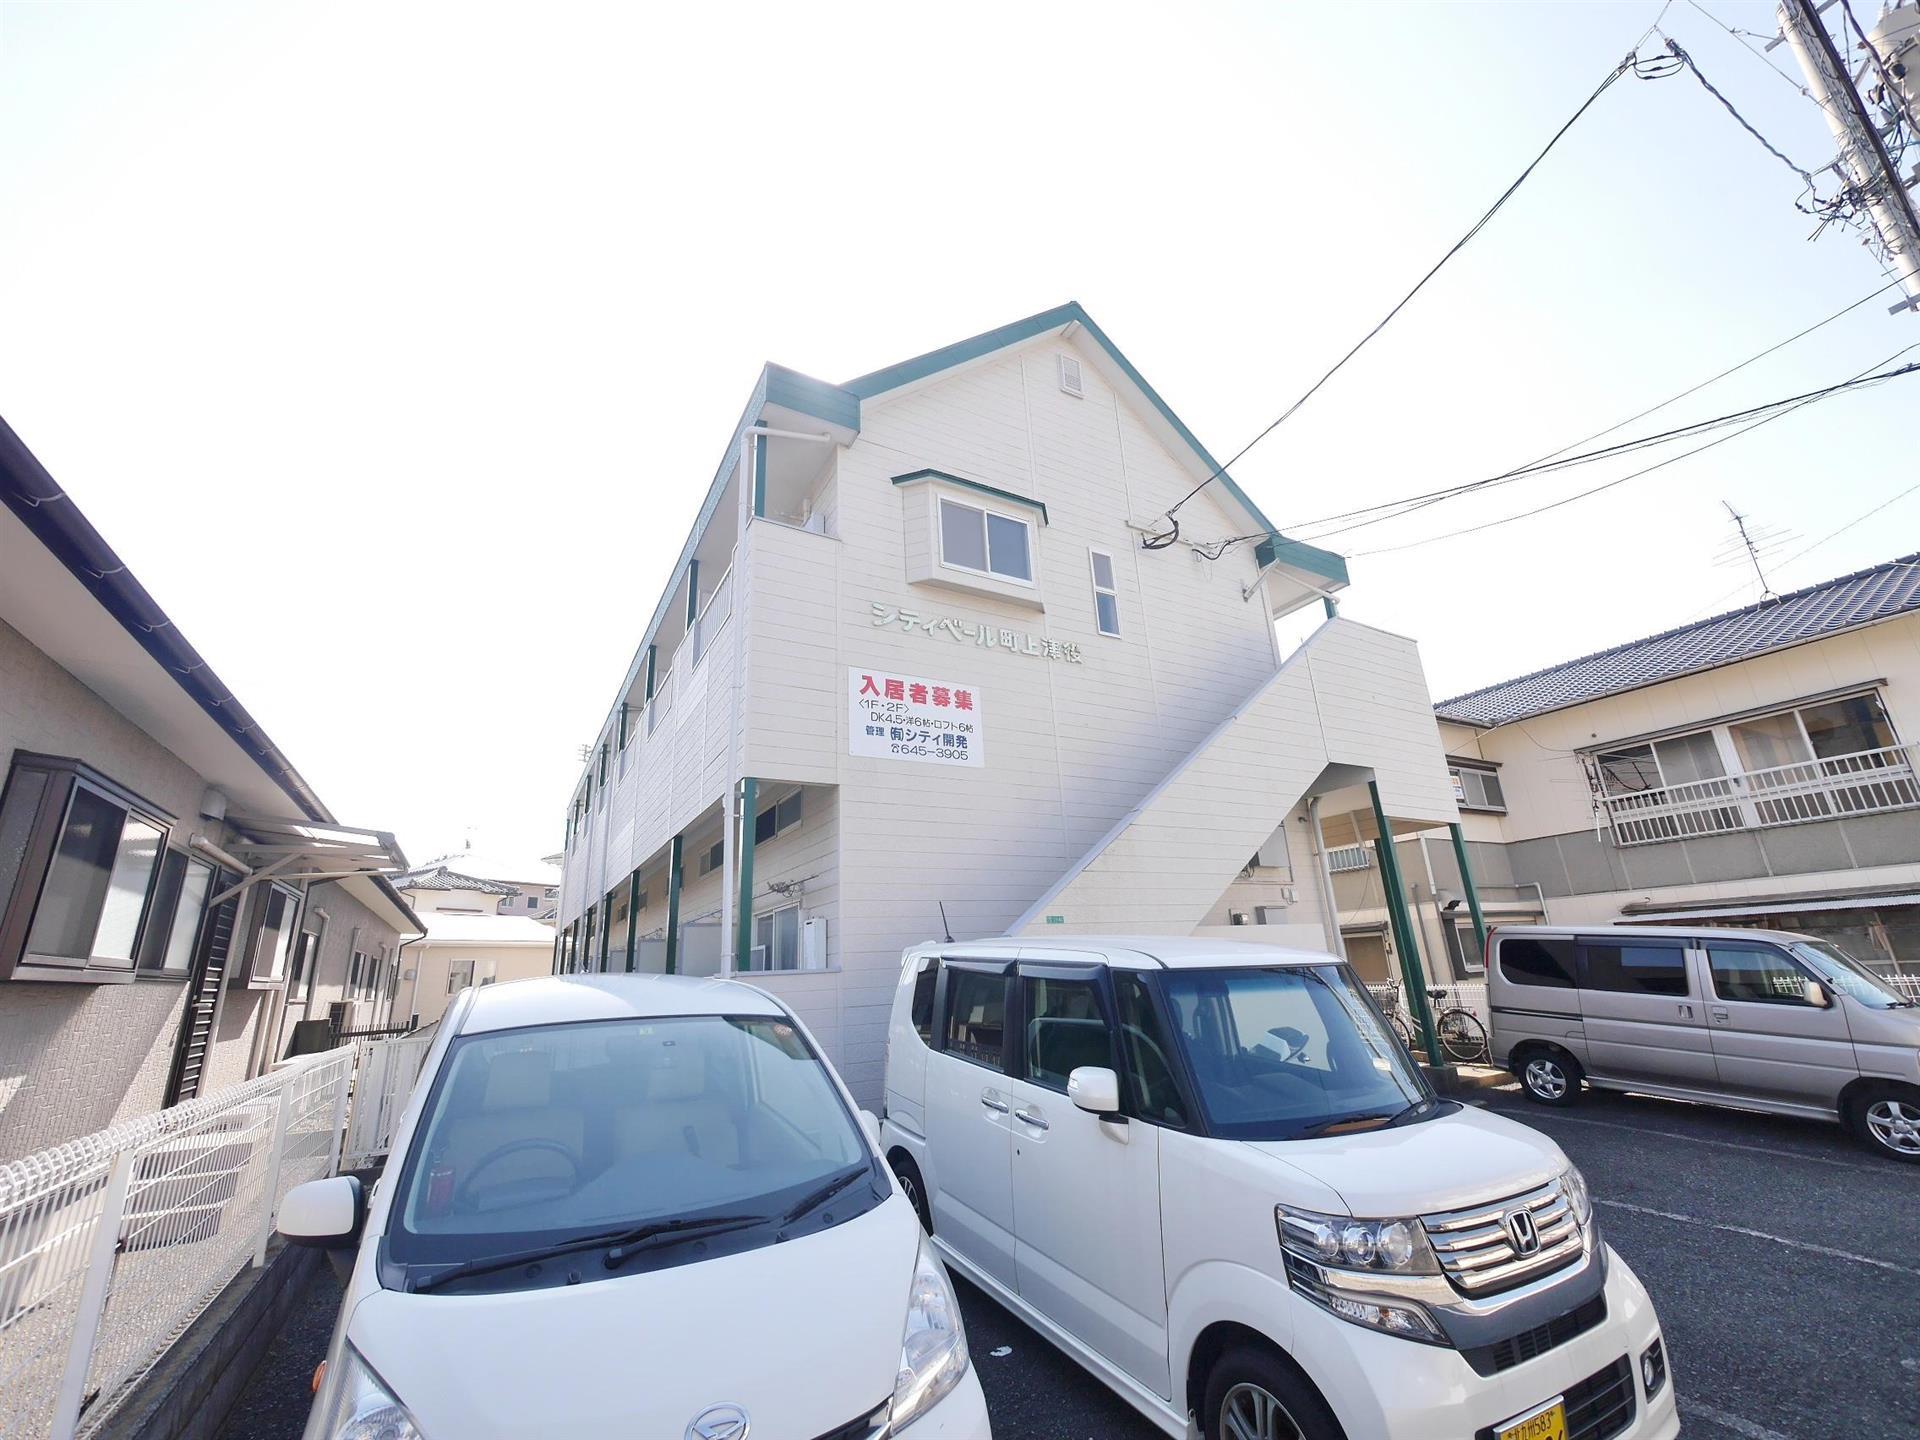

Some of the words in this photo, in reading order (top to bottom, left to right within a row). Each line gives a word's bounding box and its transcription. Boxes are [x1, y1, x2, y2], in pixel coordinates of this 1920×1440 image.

[859, 674, 973, 711] 入居者募集
[865, 725, 885, 737] 管理
